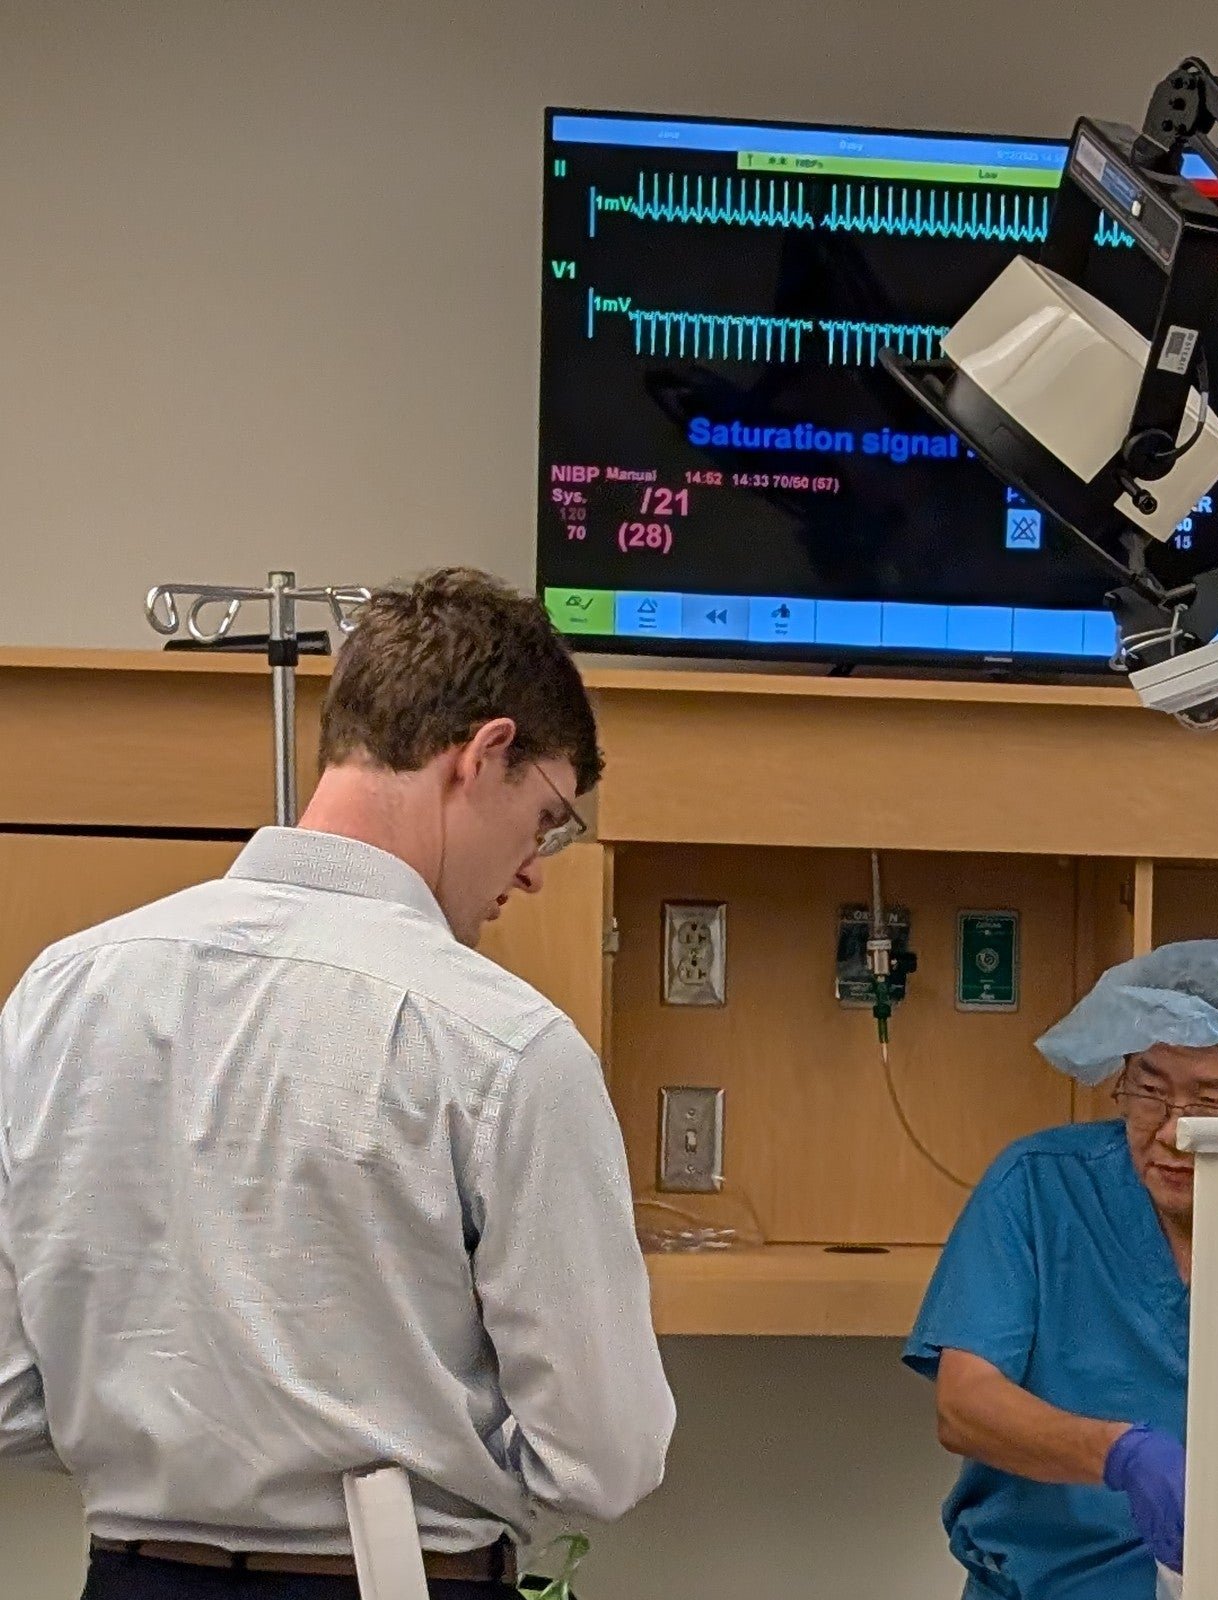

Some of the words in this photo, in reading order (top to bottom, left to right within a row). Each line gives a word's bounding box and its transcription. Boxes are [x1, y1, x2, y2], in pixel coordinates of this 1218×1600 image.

[595, 195, 633, 211] 1mV
[551, 260, 576, 279] V1
[593, 296, 631, 313] 1mV
[688, 416, 853, 453] Saturation
[860, 427, 958, 462] signal
[551, 464, 600, 483] NIBP
[640, 487, 689, 516] /21
[567, 524, 587, 541] 70
[618, 521, 673, 554] (28)
